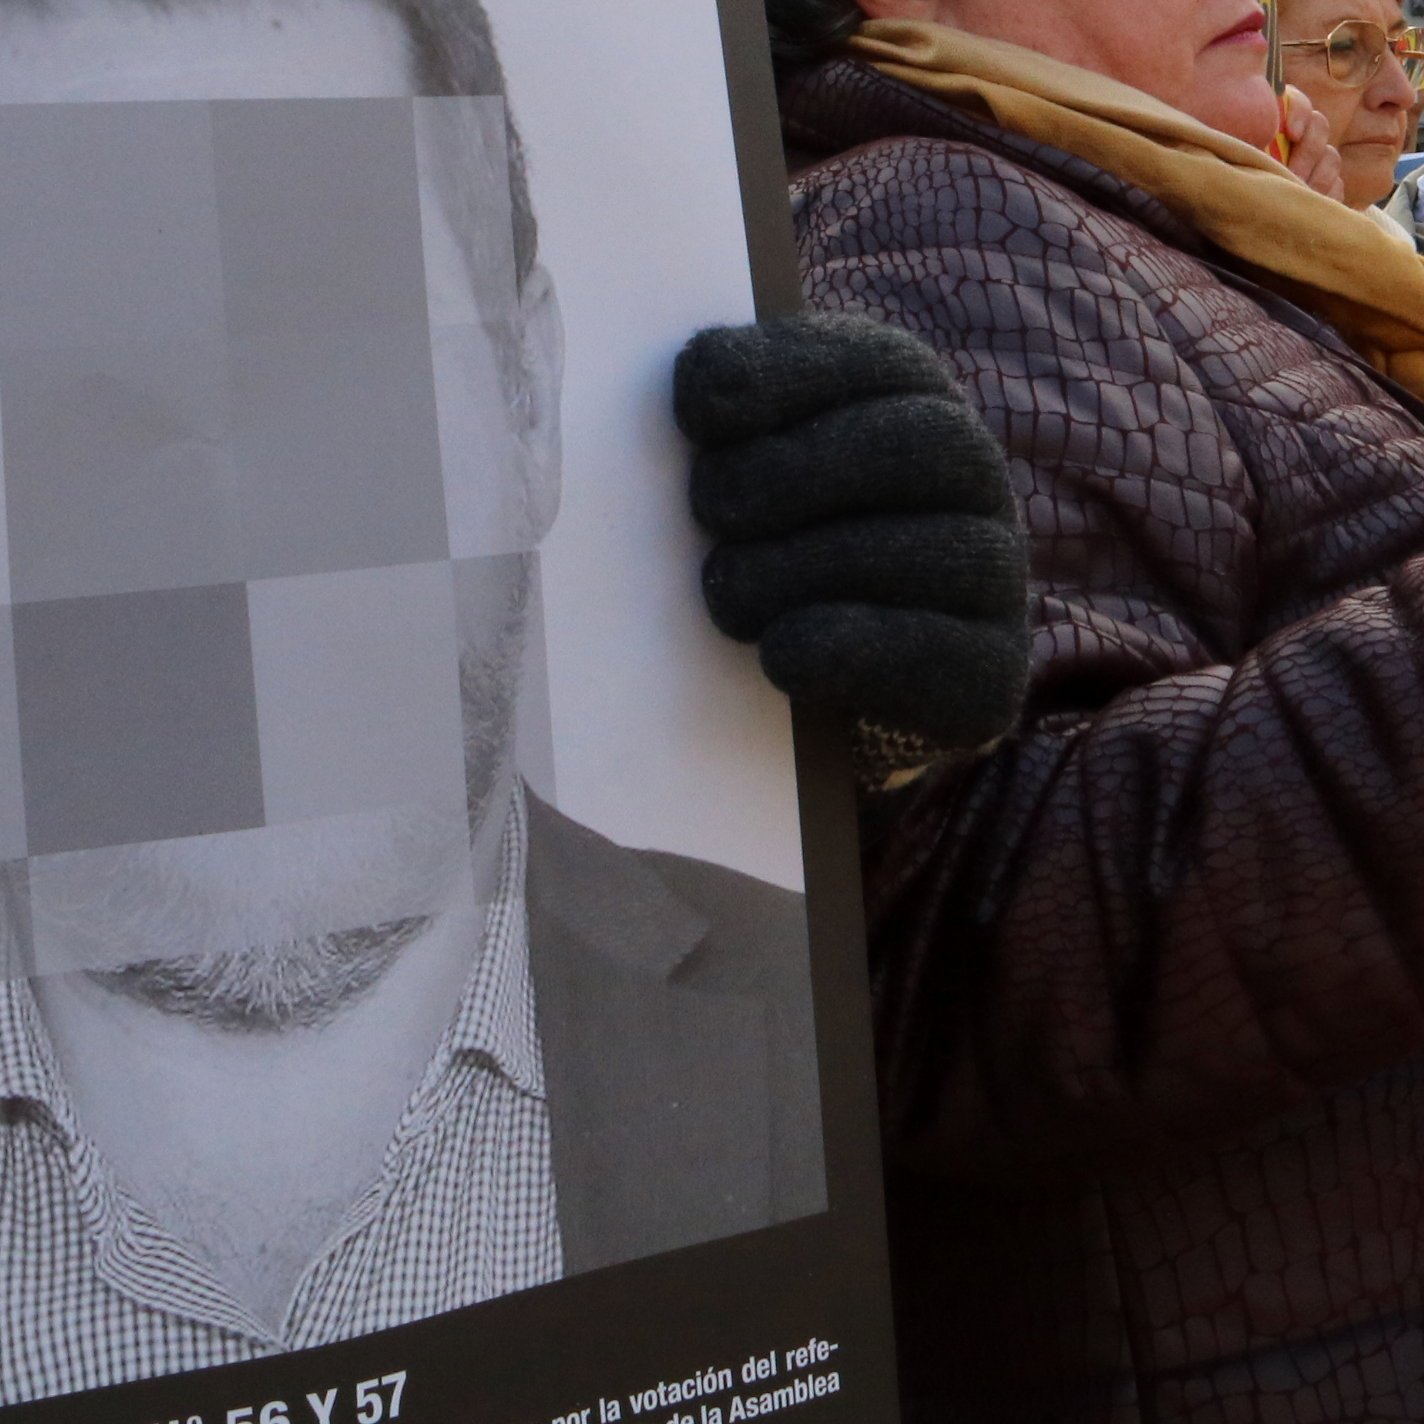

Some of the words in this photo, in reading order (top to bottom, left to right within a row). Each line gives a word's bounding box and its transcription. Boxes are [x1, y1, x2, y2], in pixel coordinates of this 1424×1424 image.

[305, 1387, 338, 1424] Y
[356, 1370, 407, 1424] 57
[599, 1397, 622, 1424] la
[629, 1366, 733, 1415] votación
[741, 1350, 777, 1384] del
[785, 1337, 840, 1371] refe-
[728, 1370, 841, 1424] Asamblea
